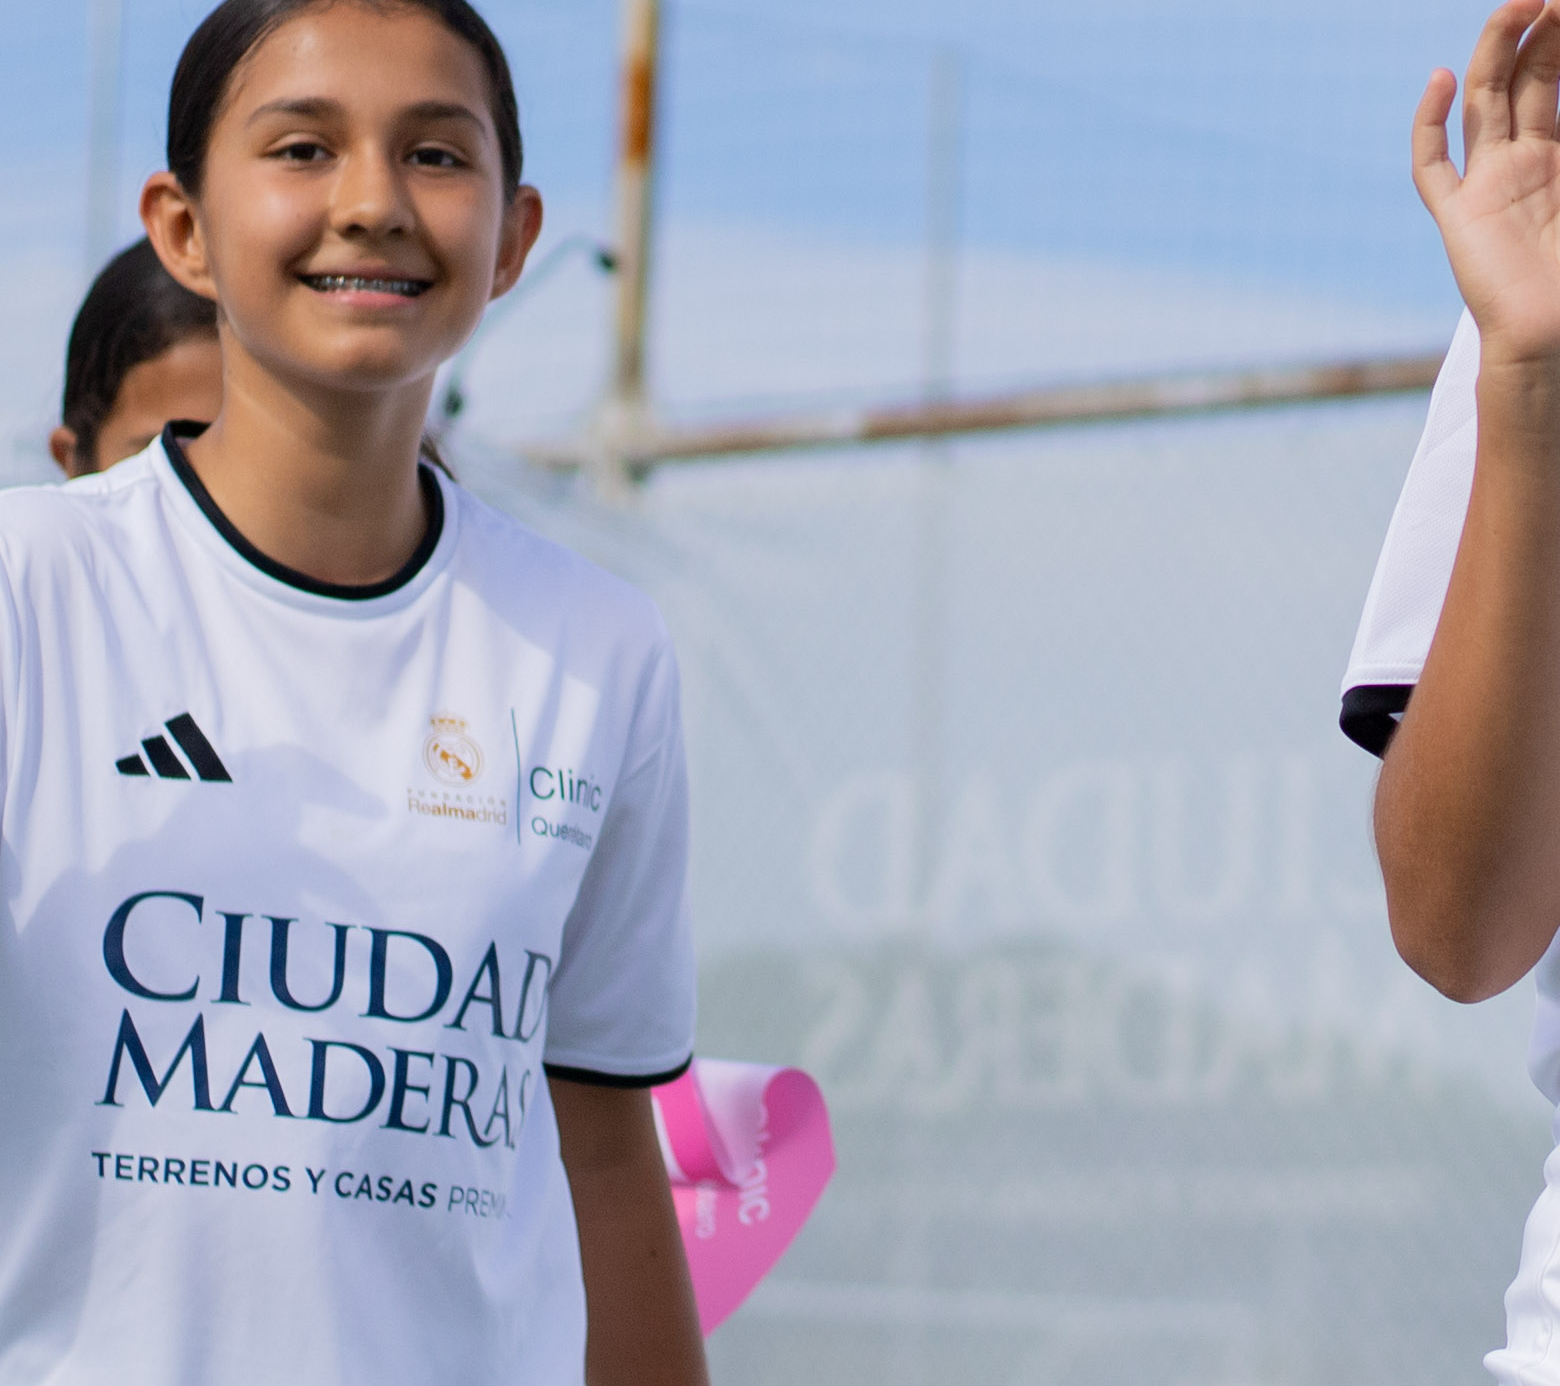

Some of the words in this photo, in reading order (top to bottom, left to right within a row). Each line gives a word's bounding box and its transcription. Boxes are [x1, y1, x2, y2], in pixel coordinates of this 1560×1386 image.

[407, 797, 508, 826] Realmadrid
[530, 766, 602, 813] Clinic
[102, 890, 552, 1045] CIUDAD
[92, 1151, 291, 1193] TERRENOS
[305, 1169, 326, 1195] Y
[334, 1172, 438, 1209] CASAS
